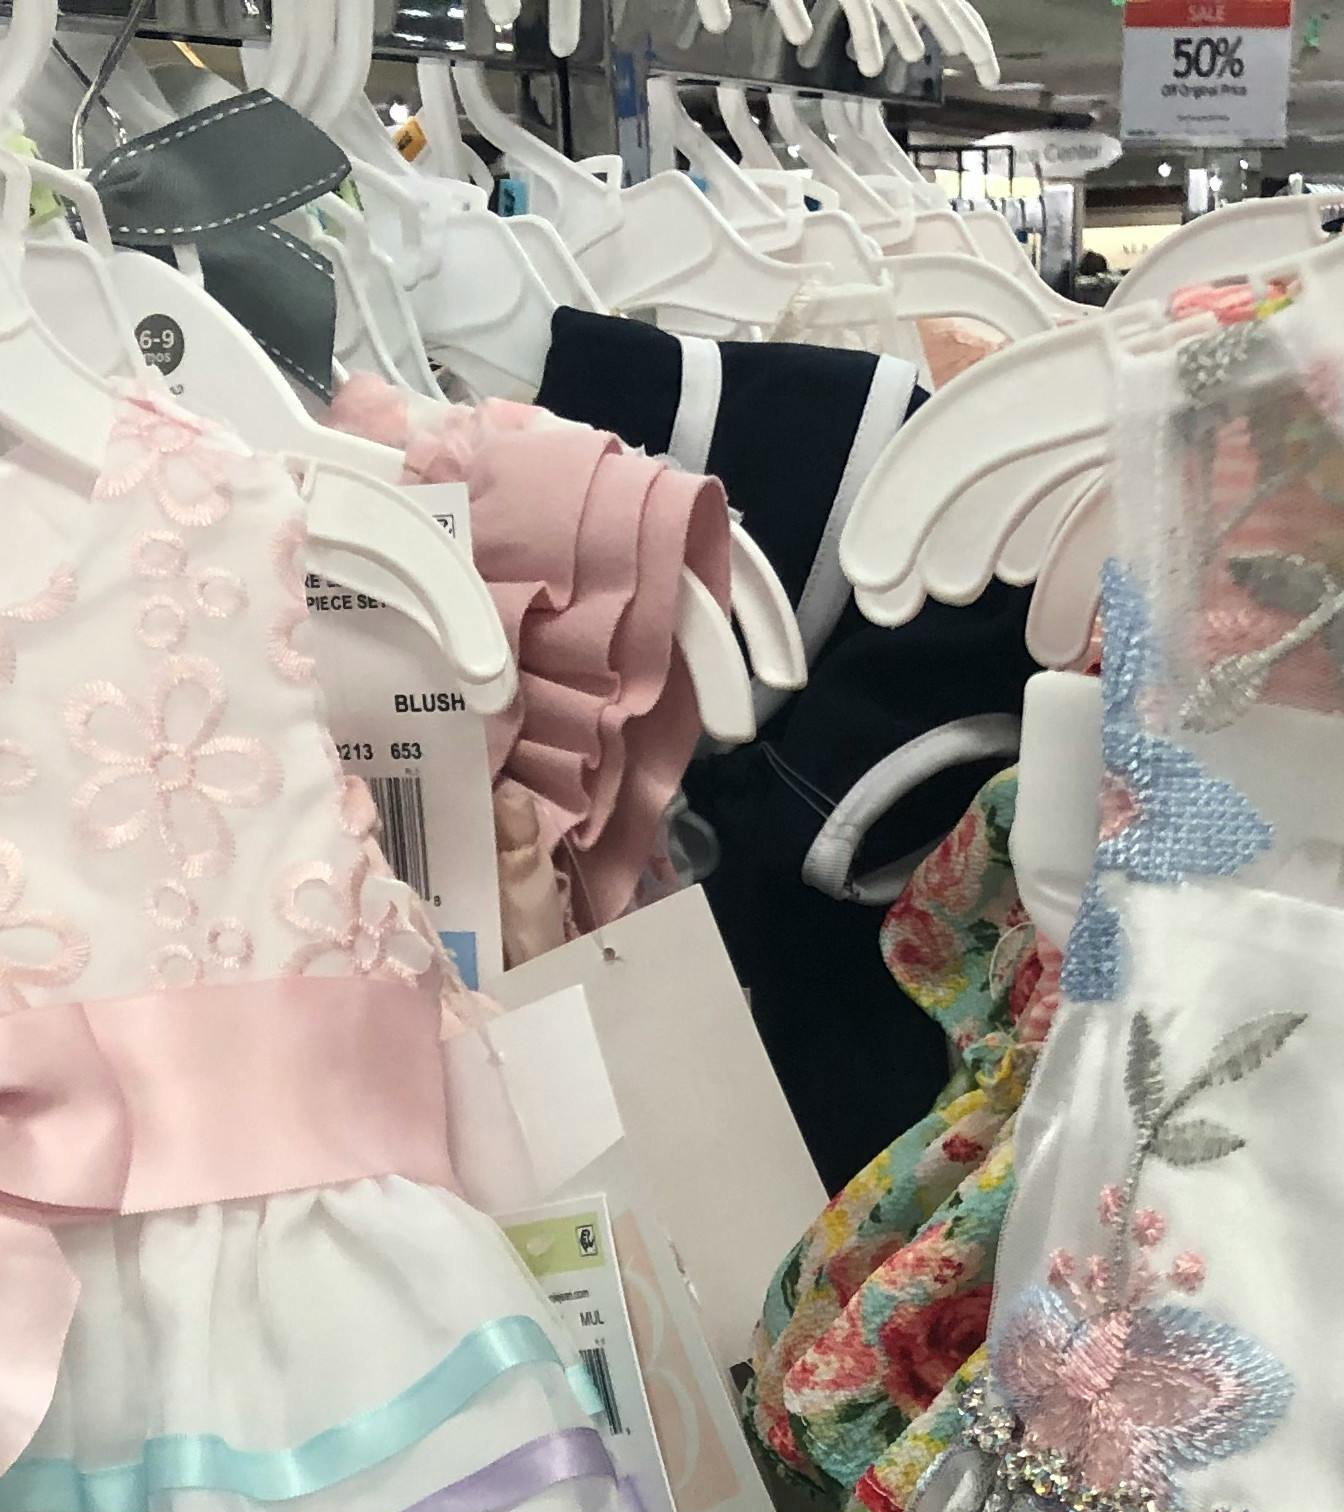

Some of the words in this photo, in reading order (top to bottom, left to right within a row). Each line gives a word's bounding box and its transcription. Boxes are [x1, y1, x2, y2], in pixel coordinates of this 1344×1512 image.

[1188, 4, 1226, 22] SALE
[1172, 36, 1245, 79] 50%
[139, 329, 175, 349] 6-9
[356, 594, 386, 609] SE
[394, 692, 466, 713] BLUSH
[390, 742, 422, 760] 653
[579, 1310, 605, 1327] MUL
